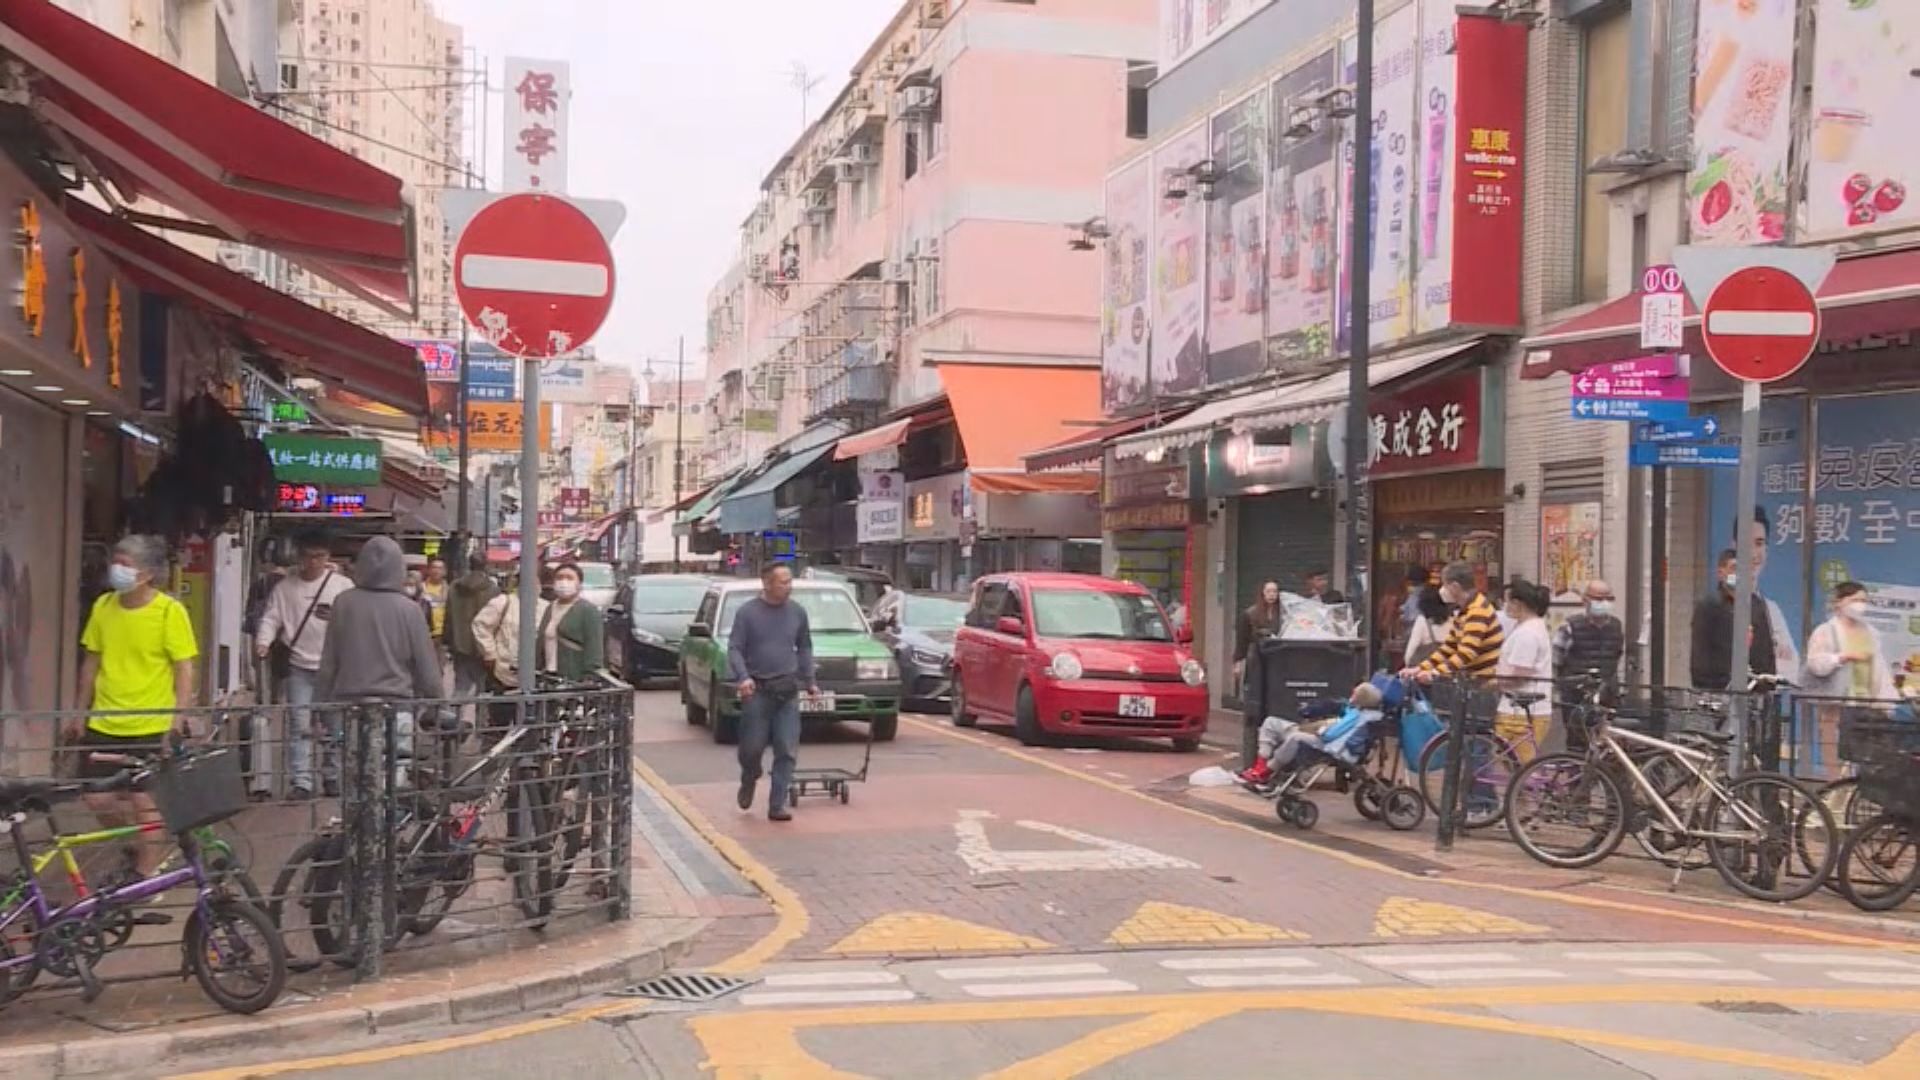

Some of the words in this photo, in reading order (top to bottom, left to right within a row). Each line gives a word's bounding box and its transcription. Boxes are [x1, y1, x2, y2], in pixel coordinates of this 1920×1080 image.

[1470, 128, 1510, 151] 惠康
[1464, 151, 1517, 166] wellcome
[1661, 299, 1680, 342] 上水
[470, 409, 524, 434] 位元
[1761, 463, 1806, 494] 癌症
